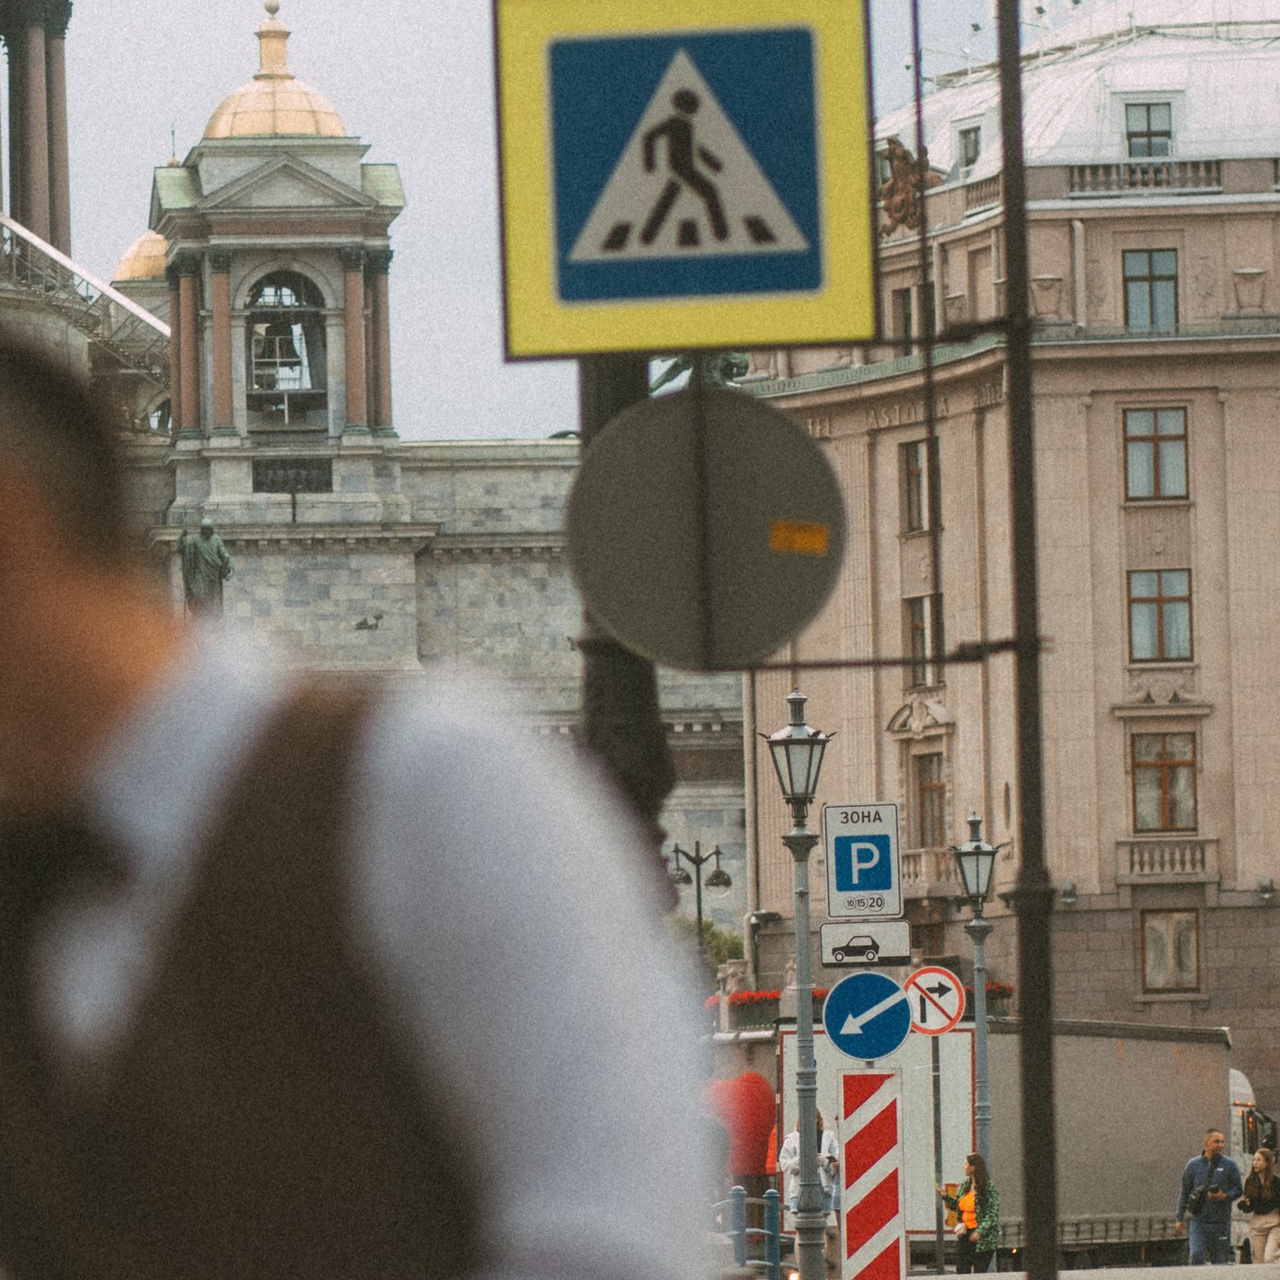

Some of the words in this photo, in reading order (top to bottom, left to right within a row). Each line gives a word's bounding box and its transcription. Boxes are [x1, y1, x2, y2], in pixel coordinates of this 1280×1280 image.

[806, 417, 833, 438] TEL
[867, 396, 949, 429] ASTORA
[840, 811, 883, 824] ЗОНА
[851, 842, 880, 885] P
[846, 899, 854, 908] 10
[856, 898, 866, 907] 15
[868, 897, 883, 908] 20
